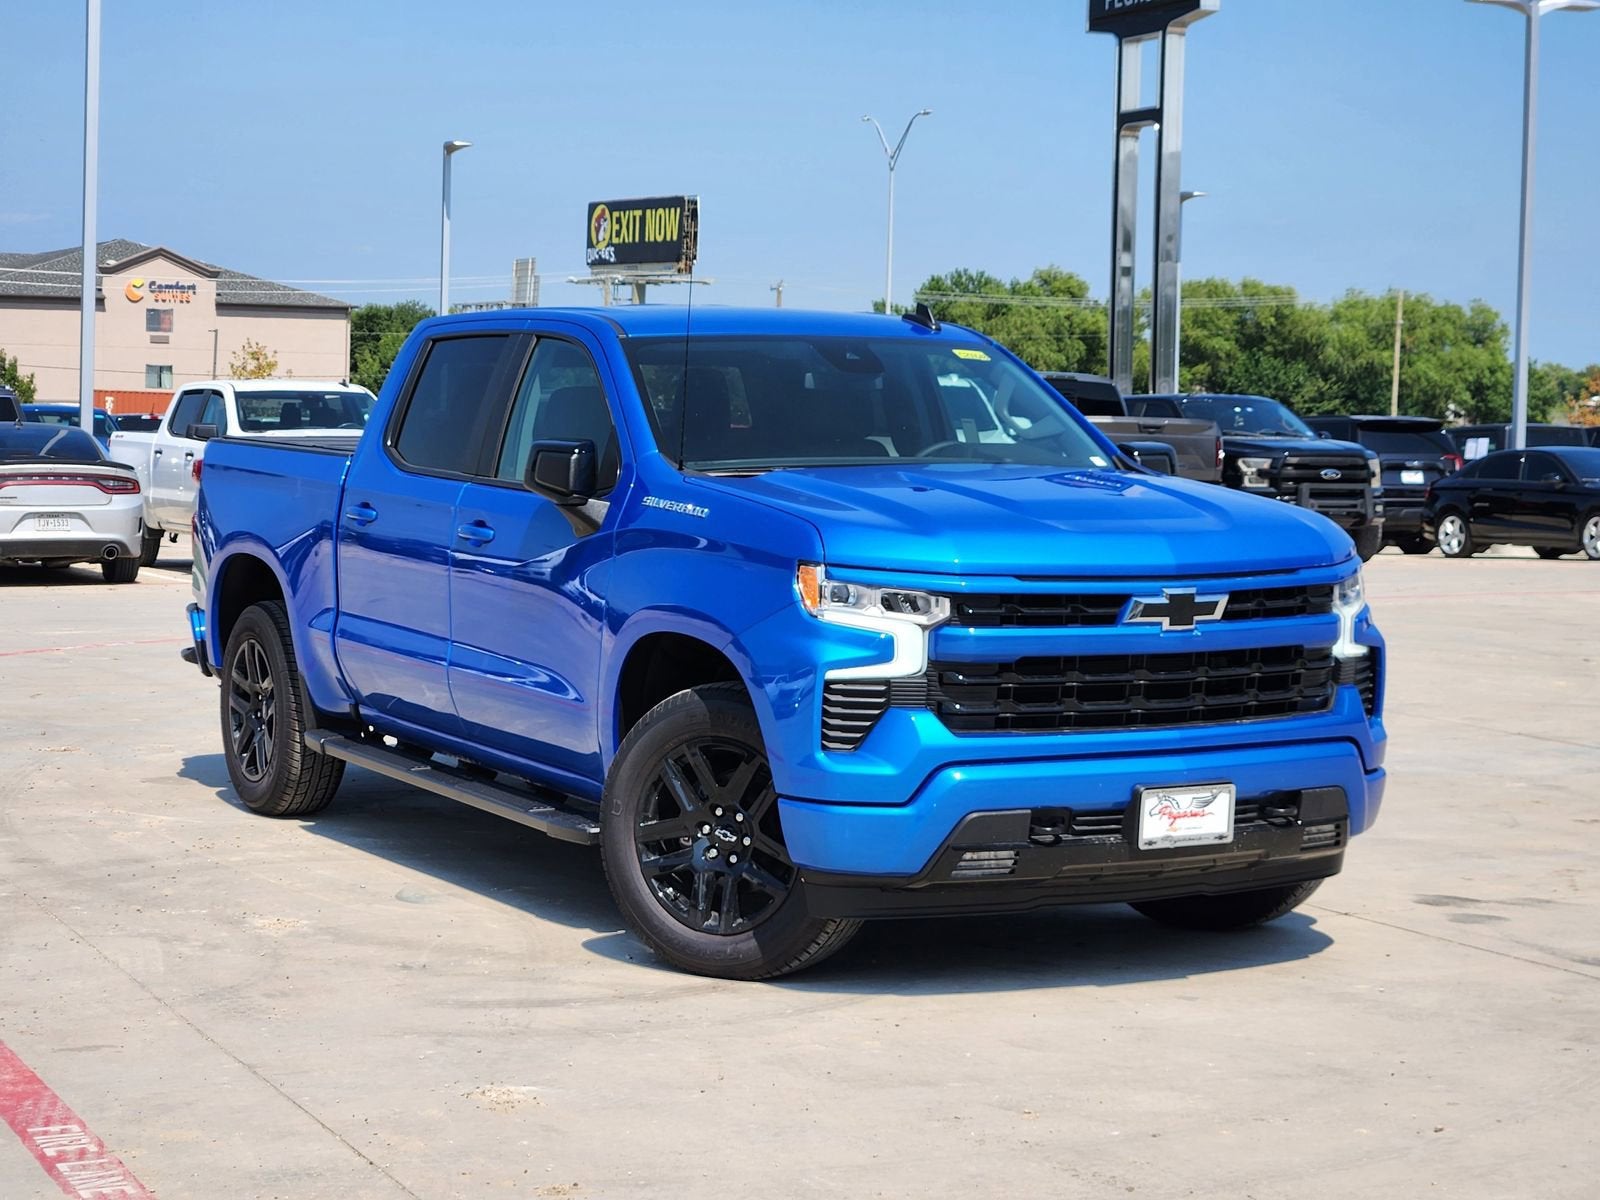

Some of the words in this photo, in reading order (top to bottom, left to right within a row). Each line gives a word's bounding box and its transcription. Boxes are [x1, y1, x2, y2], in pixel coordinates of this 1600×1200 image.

[612, 209, 642, 244] EXIT
[645, 207, 681, 243] NOW
[149, 280, 196, 292] Comfort
[641, 496, 710, 518] SILVERADO
[1158, 805, 1215, 827] Pegasus
[27, 1124, 98, 1157] FIRE
[55, 1158, 139, 1199] LANE
